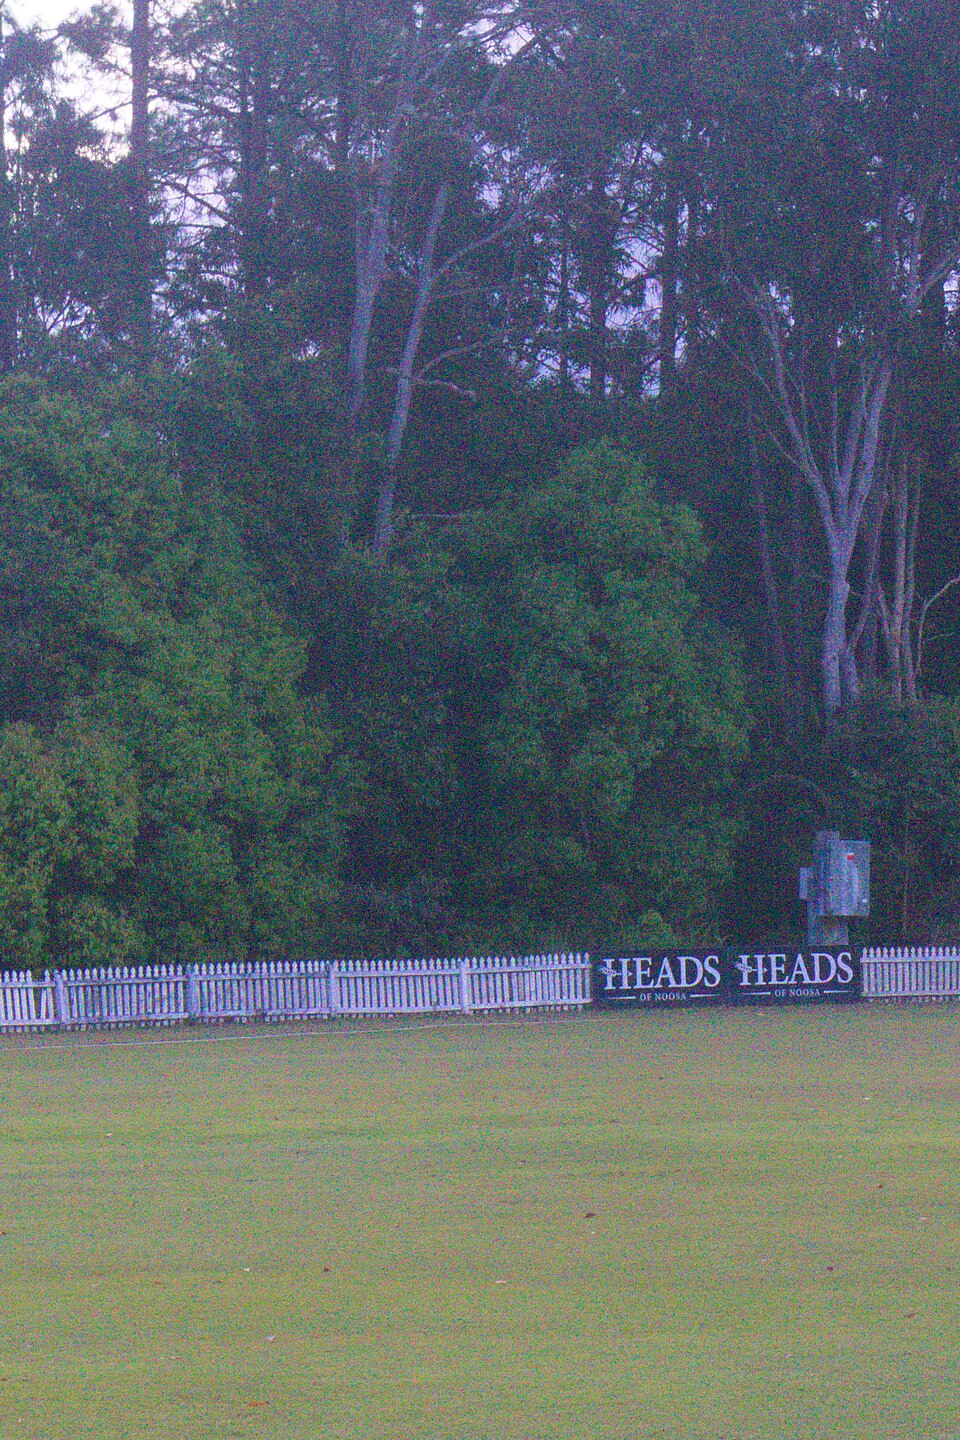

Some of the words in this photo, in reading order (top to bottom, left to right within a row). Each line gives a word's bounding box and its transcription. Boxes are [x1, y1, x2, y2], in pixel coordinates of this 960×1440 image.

[602, 955, 721, 990] HEADS
[738, 952, 854, 986] HEADS
[639, 993, 652, 1002] OF
[654, 992, 687, 1001] NOOSA
[774, 989, 787, 997] OF
[789, 988, 821, 997] NOOSA
